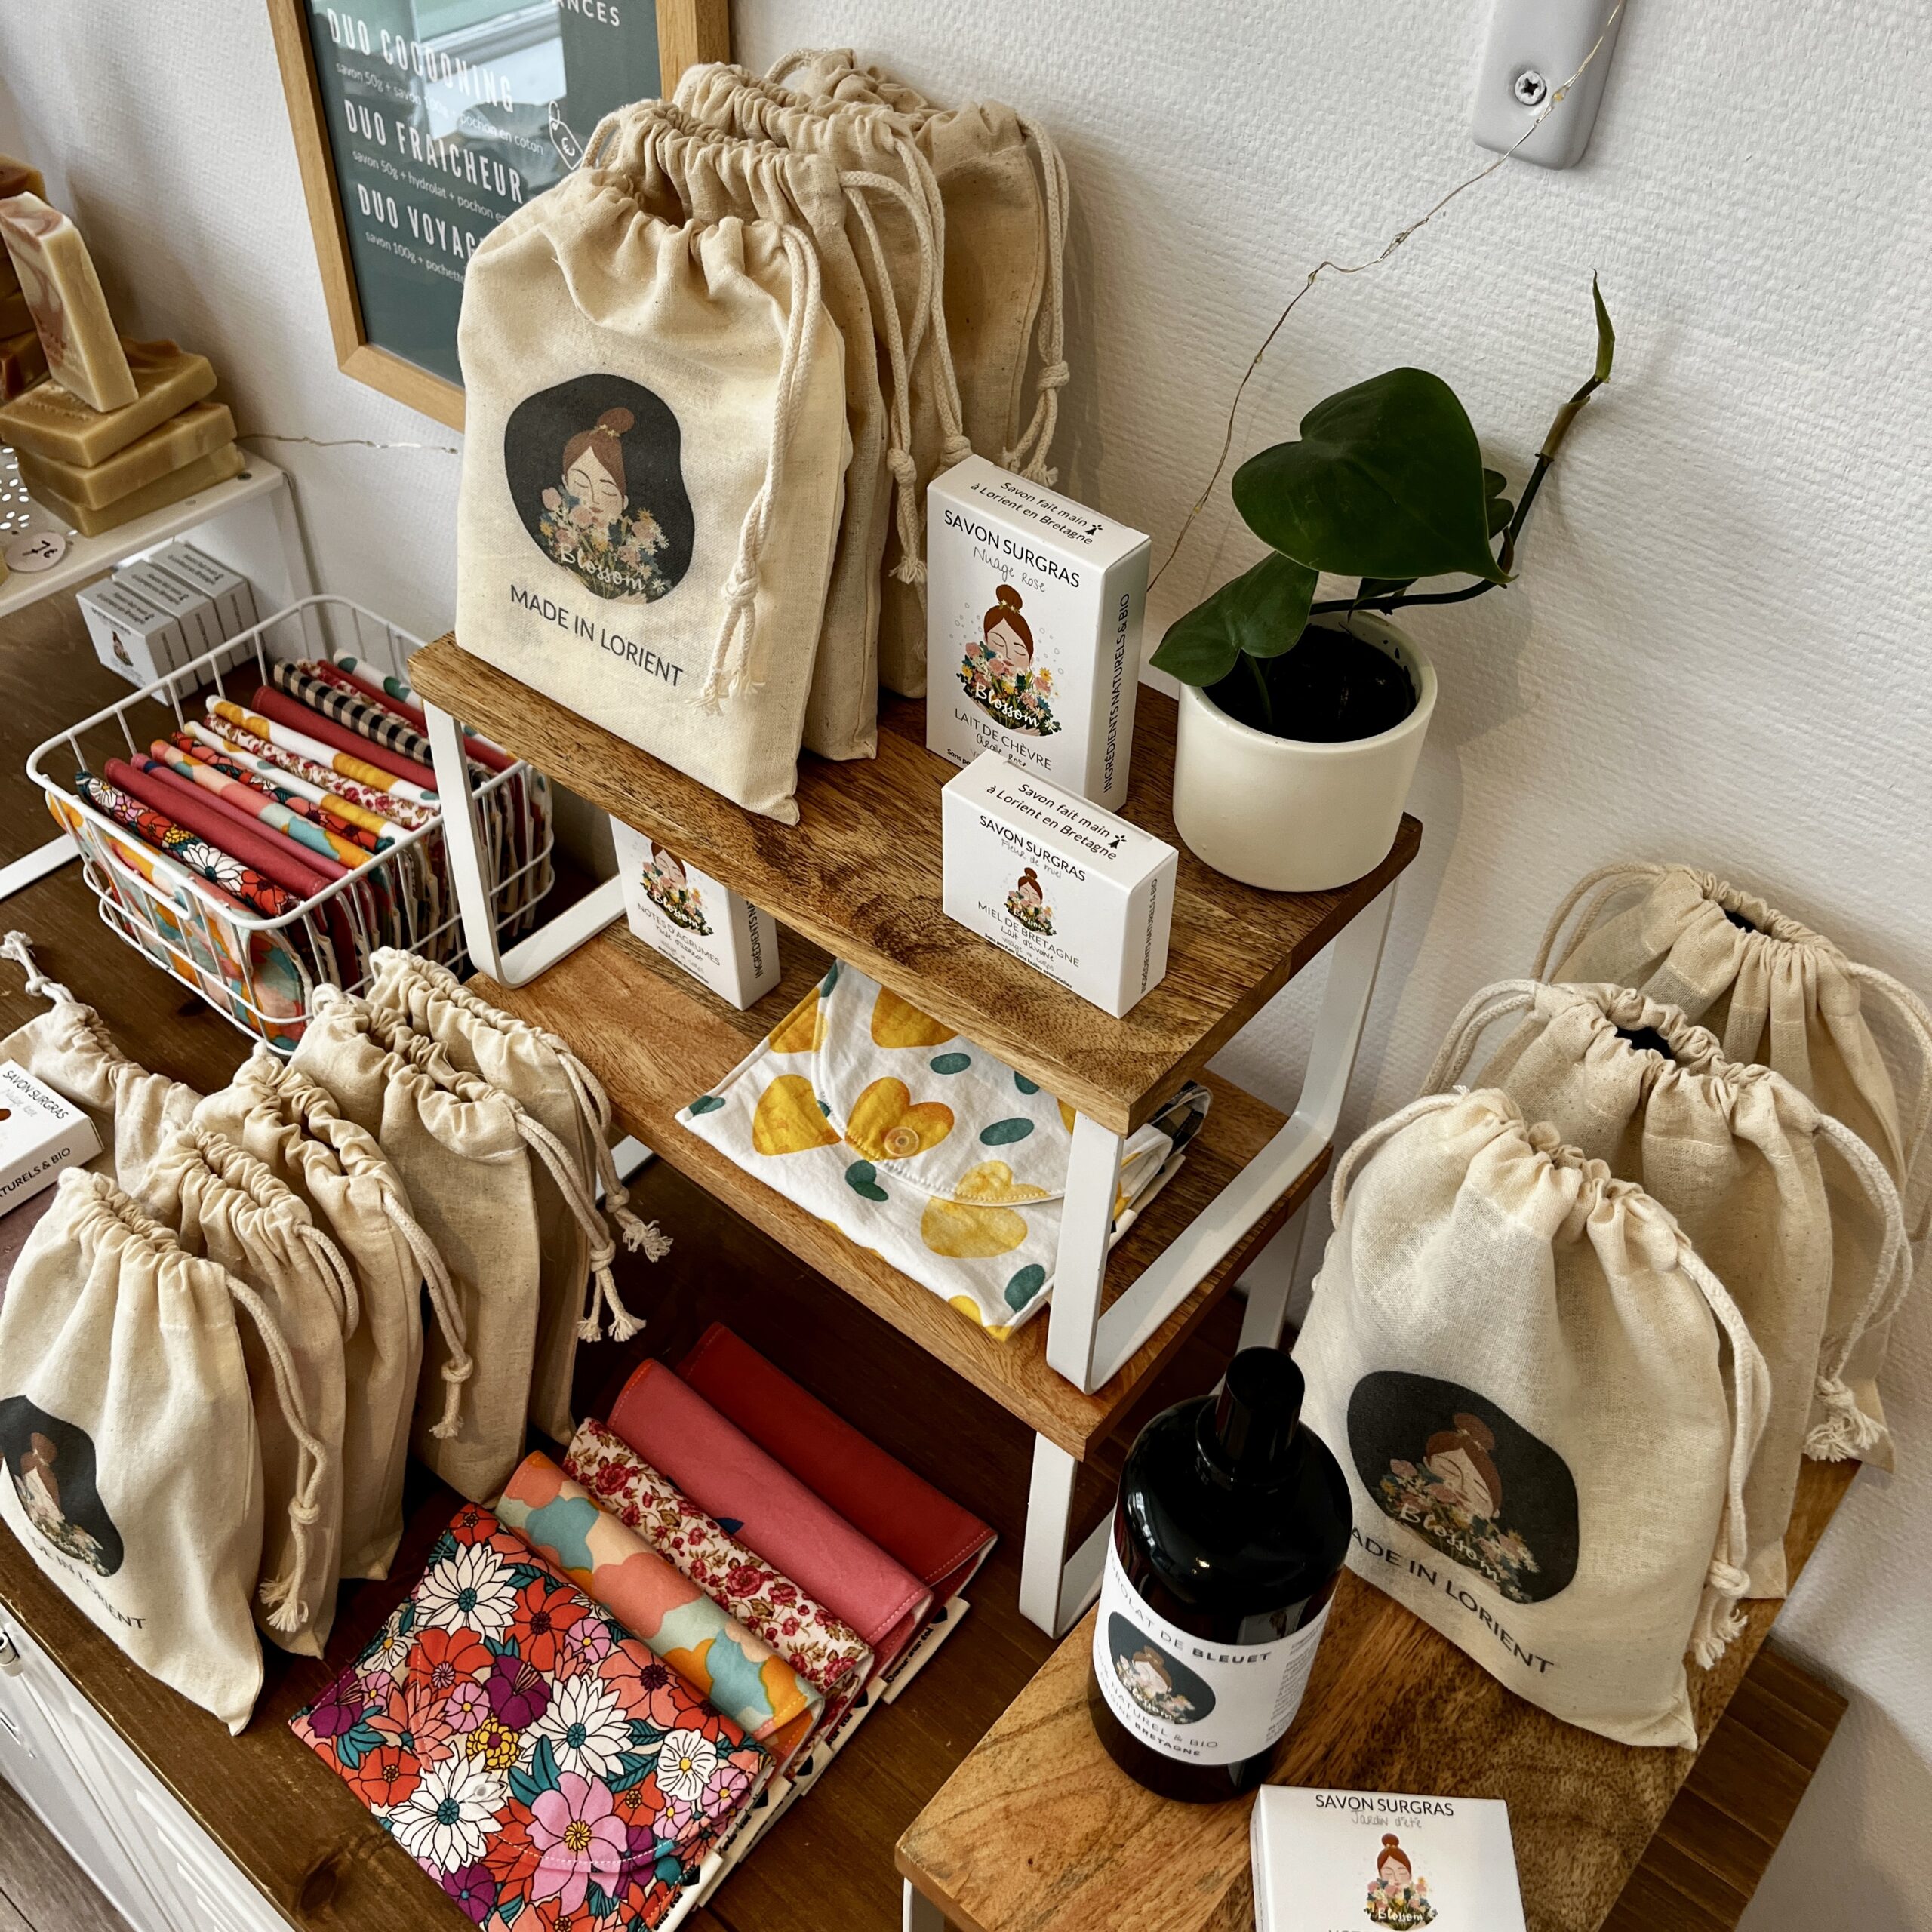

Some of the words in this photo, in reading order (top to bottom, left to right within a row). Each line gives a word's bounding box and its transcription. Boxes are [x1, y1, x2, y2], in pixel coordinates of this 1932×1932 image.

[327, 8, 371, 56] DUO
[380, 29, 514, 114] COCOONING
[336, 63, 363, 82] savon
[365, 72, 383, 92] 50g
[393, 87, 421, 105] savon
[500, 129, 512, 143] en
[514, 136, 544, 155] coton
[344, 99, 386, 146] DUO
[396, 122, 523, 204] FRAICHEUR
[352, 151, 379, 170] savon
[381, 159, 399, 180] 50g
[408, 171, 447, 199] hydrolat
[457, 195, 494, 219] pochon
[358, 183, 398, 229] DUO
[407, 205, 484, 259] VOYAG
[365, 231, 392, 251] savon
[393, 242, 417, 264] 100g
[980, 487, 1023, 512] Lorient
[1023, 509, 1038, 519] en
[1039, 515, 1094, 545] Bretagne
[1001, 482, 1035, 502] Savon
[1036, 499, 1058, 512] fait
[1057, 510, 1088, 527] main
[560, 544, 646, 592] Blossom
[944, 509, 1000, 549] SAVON
[1003, 539, 1080, 588] SURGRAS
[973, 546, 1014, 582] Nuage
[510, 583, 568, 629] MADE
[574, 614, 595, 642] IN
[601, 628, 683, 687] LORIENT
[1118, 622, 1127, 633] &
[1119, 593, 1130, 622] BIO
[1111, 634, 1126, 706] NATURELS
[975, 682, 1040, 727] Blossom
[955, 708, 980, 730] LAIT
[983, 724, 999, 742] DE
[1001, 735, 1052, 771] CHÈVRE
[1103, 707, 1119, 793] INGRÉDIENTS
[986, 785, 997, 794] à
[996, 789, 1042, 820] Lorient
[1042, 816, 1058, 829] en
[1060, 825, 1117, 860] Bretagne
[1018, 783, 1055, 808] Savon
[1057, 804, 1078, 820] fait
[1078, 817, 1111, 838] main
[980, 815, 1023, 848] SAVON
[1026, 841, 1085, 881] SURGRAS
[638, 903, 666, 928] NOTES
[978, 901, 1002, 922] MIEL
[1004, 917, 1019, 932] DE
[1021, 927, 1080, 968] BRETAGNE
[2, 1070, 33, 1093] SAVON
[28, 1090, 69, 1119] SURGRAS
[42, 1161, 51, 1170] &
[51, 1147, 71, 1164] BIO
[1401, 1503, 1501, 1582] Blossom
[78, 1571, 146, 1629] LORIENT
[1351, 1527, 1401, 1566] ADE
[1410, 1560, 1438, 1584] IN
[1446, 1580, 1554, 1673] LORIENT
[1161, 1630, 1183, 1651] DE
[1192, 1647, 1272, 1663] BLEUET
[1112, 1681, 1168, 1736] NATUREL
[1174, 1734, 1183, 1743] &
[1190, 1738, 1218, 1749] BIO
[1135, 1722, 1201, 1756] BRETAGNE
[1315, 1794, 1374, 1811] SAVON
[1377, 1798, 1454, 1817] SURGRAS
[1378, 1906, 1423, 1923] Blossom
